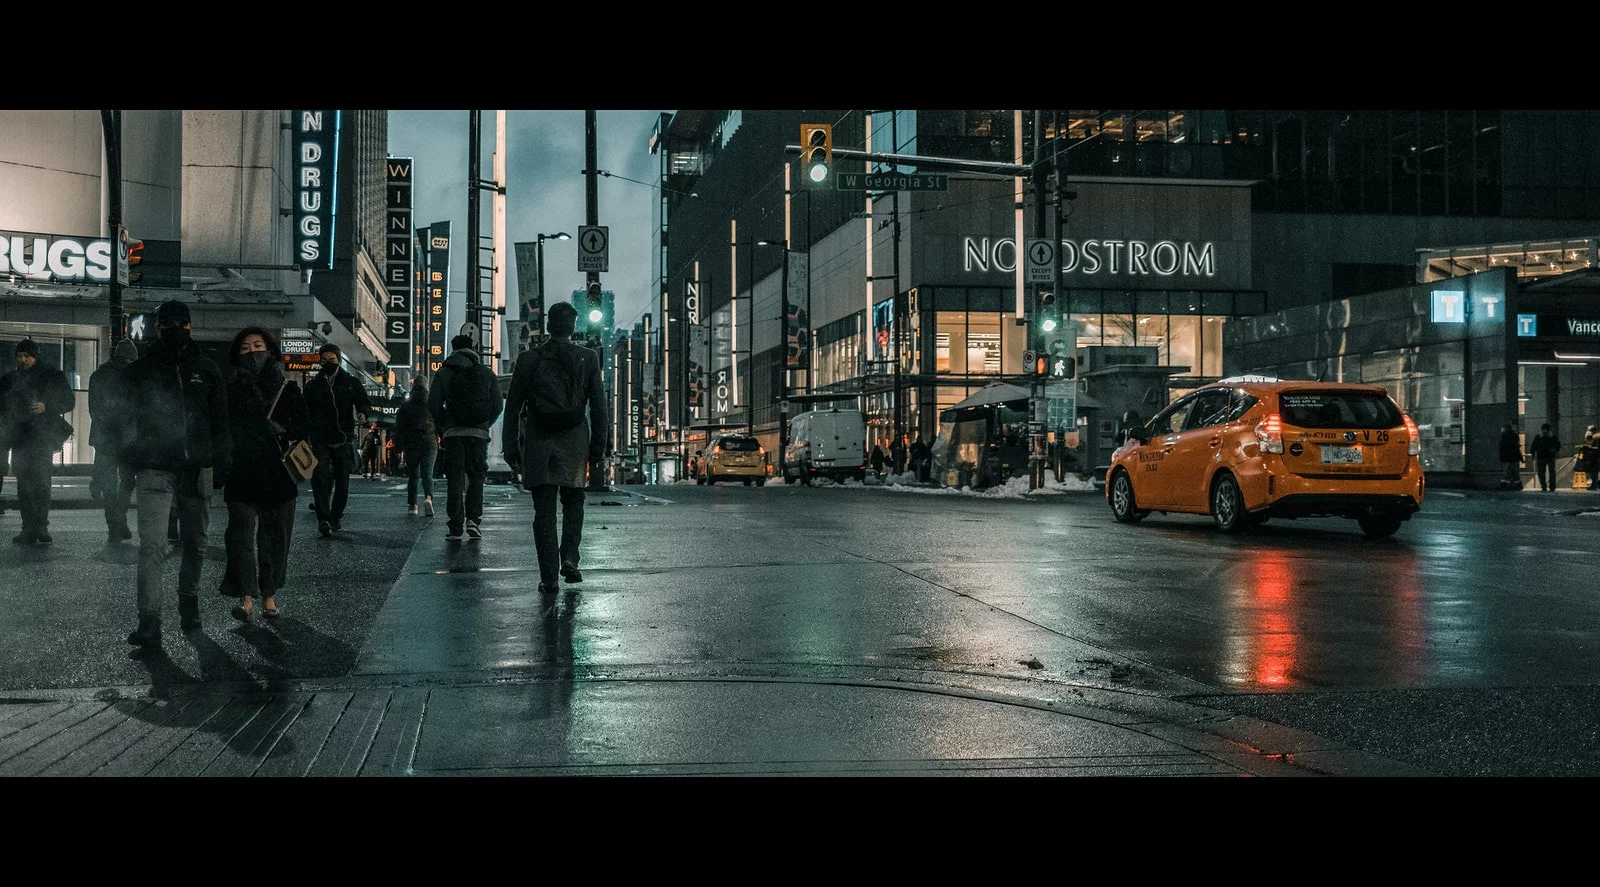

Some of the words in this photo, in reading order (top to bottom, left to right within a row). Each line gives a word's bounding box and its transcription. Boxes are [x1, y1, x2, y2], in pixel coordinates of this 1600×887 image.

[301, 142, 322, 260] DRUGS
[846, 175, 857, 187] W
[865, 175, 920, 190] Georgia
[927, 176, 941, 188] St
[0, 235, 111, 279] UGS
[388, 164, 410, 334] WINNERS
[964, 238, 1215, 276] NODSTROM
[431, 271, 443, 331] BEST
[1441, 295, 1459, 318] T
[1520, 317, 1533, 333] T
[1363, 430, 1370, 441] V
[1376, 430, 1389, 442] 26
